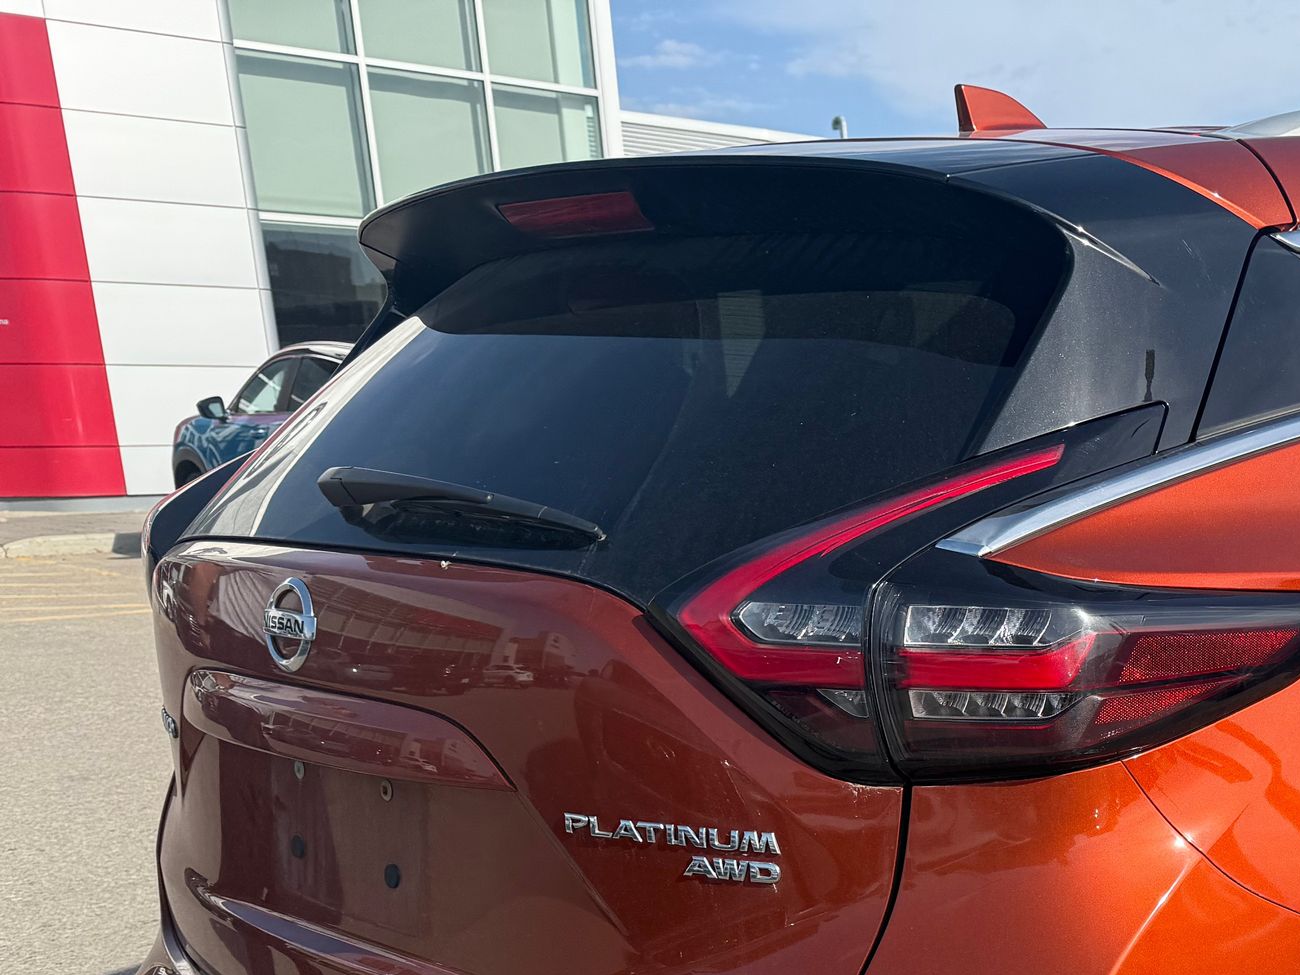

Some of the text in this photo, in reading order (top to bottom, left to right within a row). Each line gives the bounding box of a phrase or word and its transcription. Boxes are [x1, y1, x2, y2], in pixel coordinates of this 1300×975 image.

[264, 613, 305, 633] NISSAN
[563, 812, 781, 855] PLATINUM
[683, 855, 781, 884] AWD
